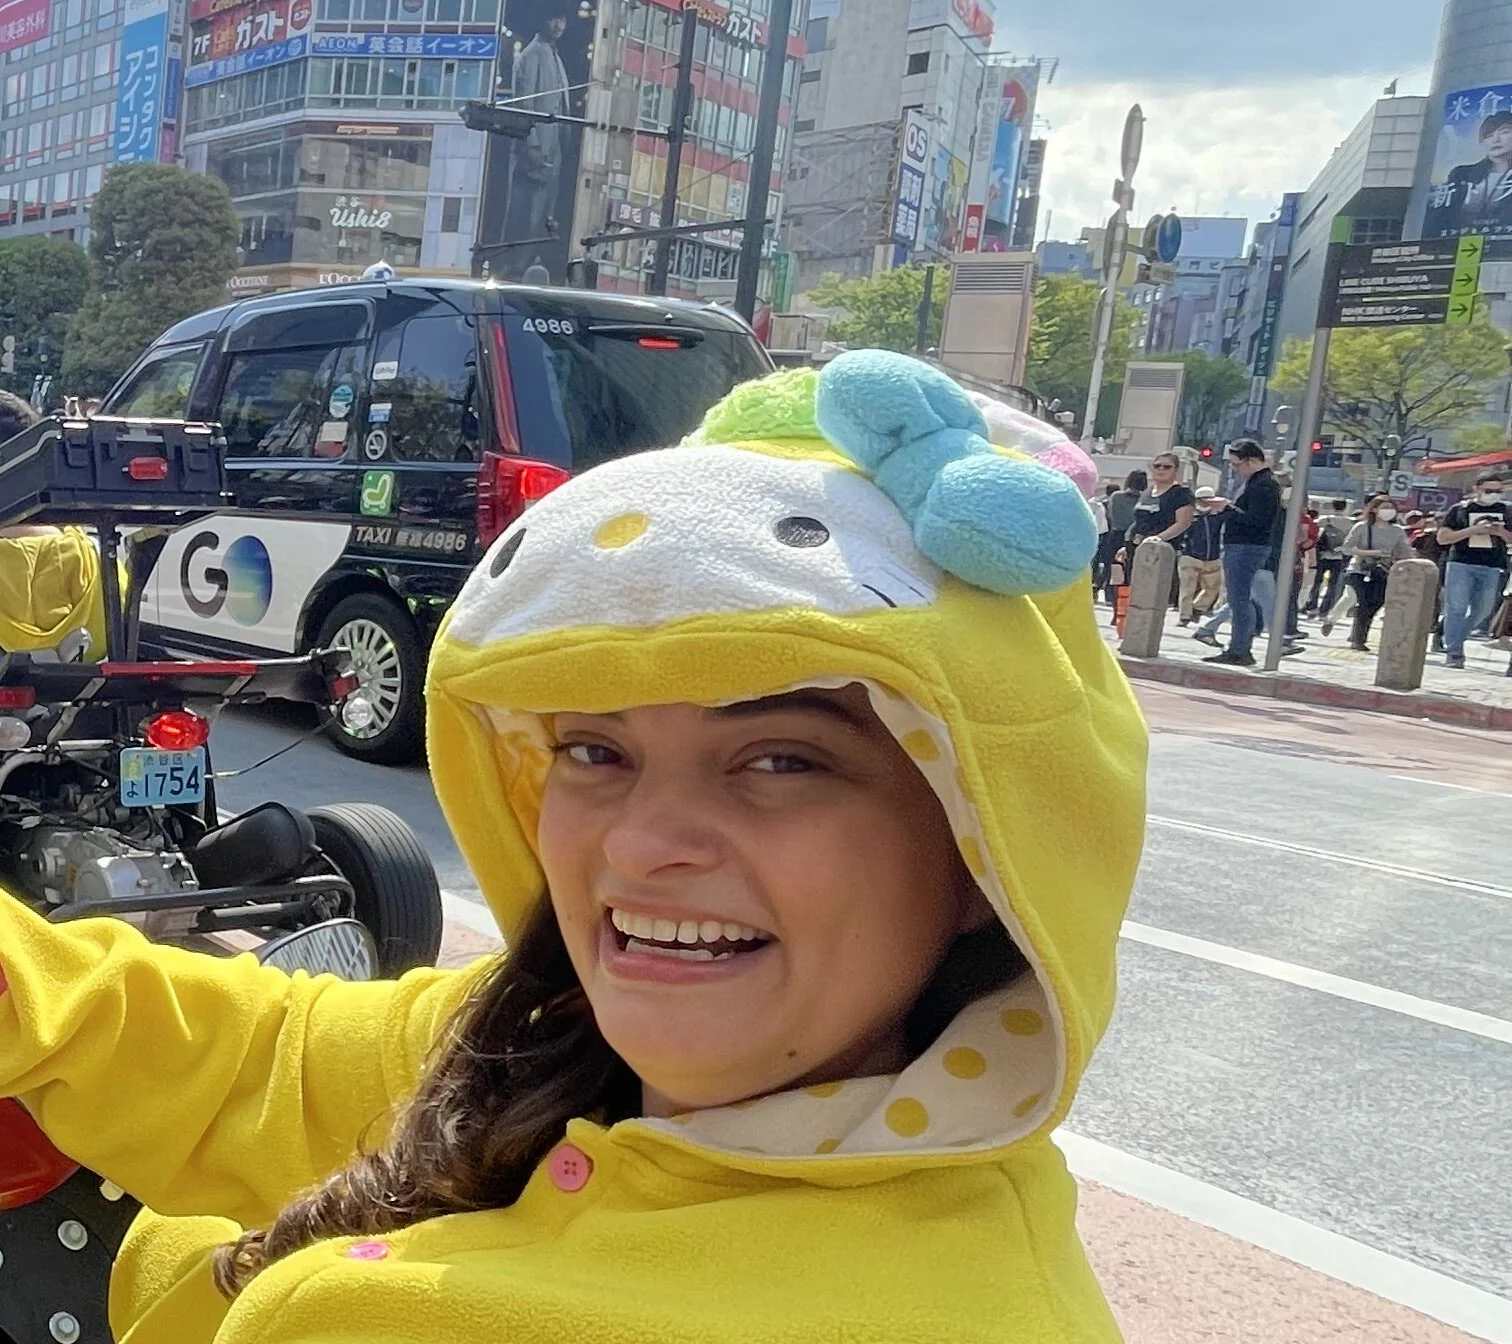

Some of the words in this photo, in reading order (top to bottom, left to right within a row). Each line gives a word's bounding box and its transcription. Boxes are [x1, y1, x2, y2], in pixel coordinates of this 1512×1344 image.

[235, 10, 285, 51] ガスト
[726, 12, 762, 43] ガスト
[194, 33, 211, 56] 7F
[368, 36, 493, 54] 英会話イーオン
[138, 45, 159, 161] コンタク
[1448, 91, 1512, 121] 米倉
[907, 126, 927, 157] OS
[330, 207, 392, 229] Ushi8
[522, 318, 574, 335] 4986
[356, 526, 393, 544] TAXI
[127, 780, 139, 798] よ
[144, 765, 200, 798] 1754
